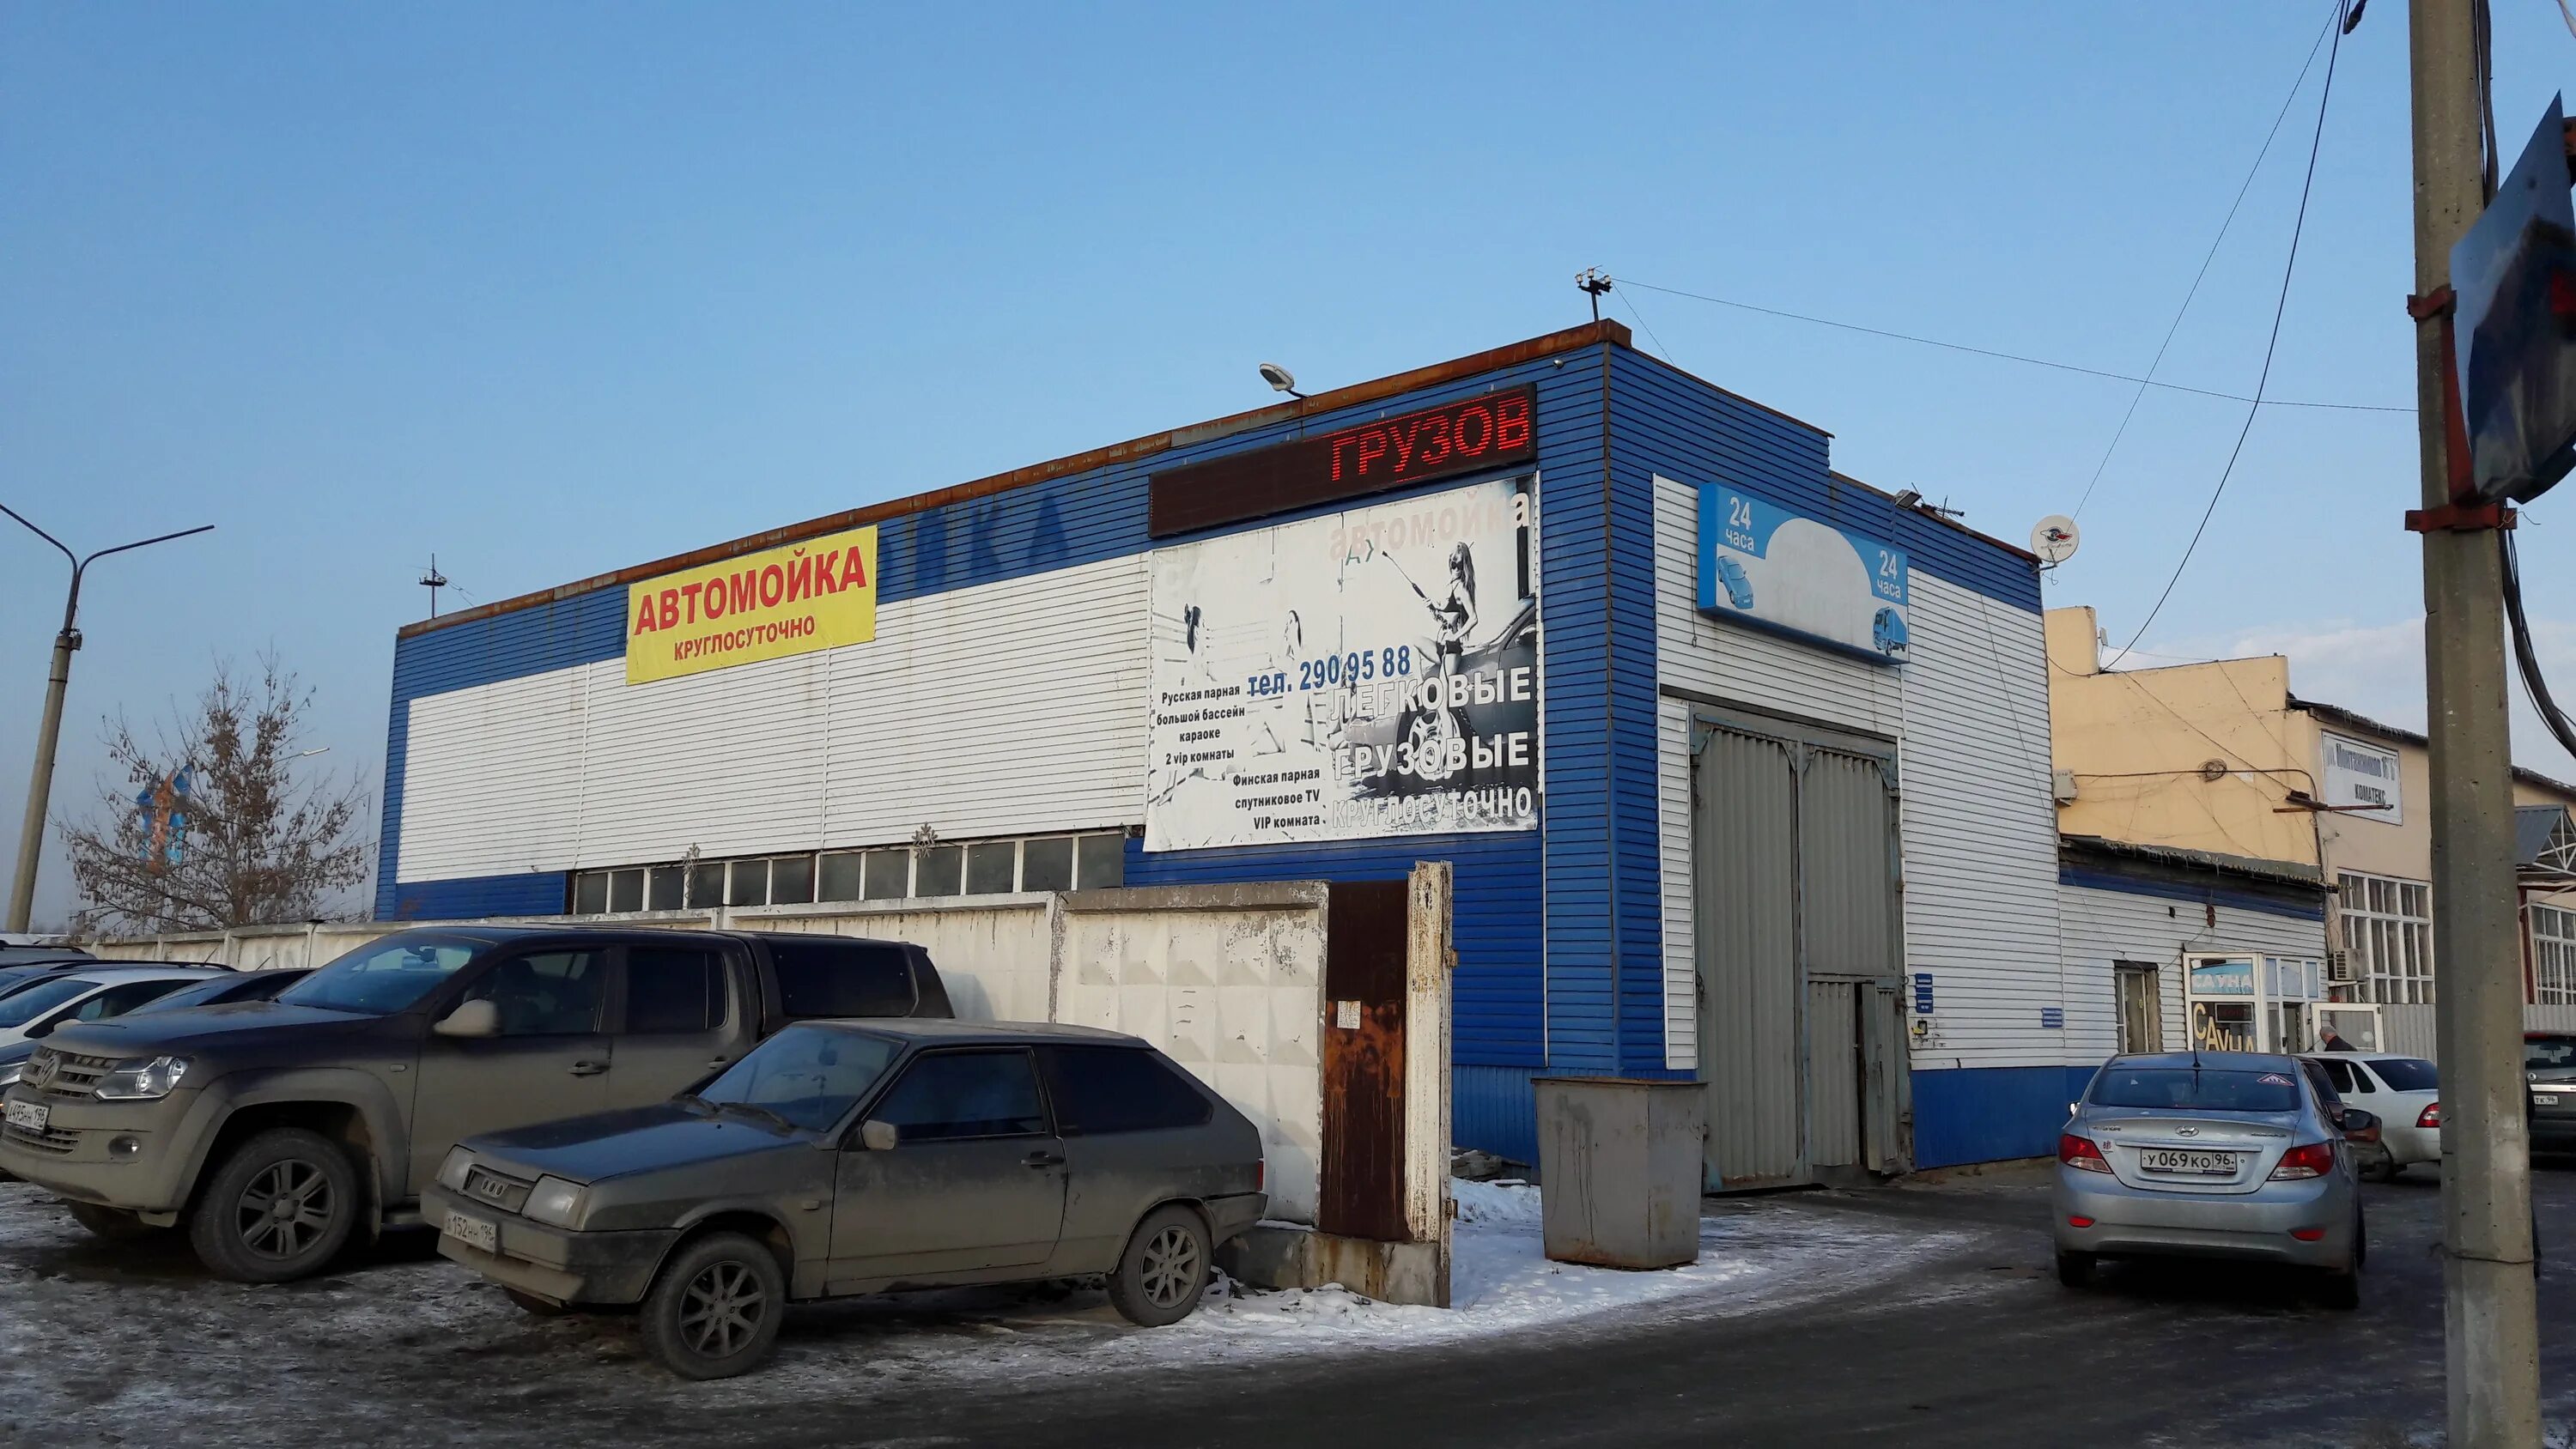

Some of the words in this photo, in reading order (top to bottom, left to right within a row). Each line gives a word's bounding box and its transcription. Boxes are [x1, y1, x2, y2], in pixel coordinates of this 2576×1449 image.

[1331, 395, 1530, 482] ГРУЗОВ
[1729, 496, 1752, 530] 24
[1726, 528, 1754, 552] часа
[1880, 549, 1898, 579] 24
[634, 546, 867, 635] АВТОМОЙКА
[1876, 580, 1901, 599] часа
[674, 615, 815, 661] КРУГЛОСУТОЧНО
[1248, 672, 1292, 697] тел.
[1299, 655, 1340, 691] 290
[1347, 650, 1374, 682] 95
[1382, 646, 1410, 677] 88
[1162, 689, 1202, 704] Русская
[1204, 686, 1240, 702] парная
[1331, 666, 1531, 721] ЛЕГКОВЫЕ
[1157, 709, 1200, 725] большой
[1202, 705, 1245, 721] бассейн
[1180, 728, 1220, 743] караоке
[1165, 754, 1172, 765] 2
[1174, 752, 1188, 766] vip
[1190, 749, 1234, 764] комнаты
[1334, 731, 1529, 780] ГРУЗОВЫЕ
[1233, 772, 1279, 788] Финская
[1281, 769, 1320, 785] парная
[1235, 792, 1303, 810] спутниковое
[1306, 789, 1321, 803] TV
[2354, 783, 2386, 804] КОМАТЕКС
[1332, 786, 1532, 828] КРУГЛОСУТОЧНО
[1254, 815, 1271, 830] VIP
[1273, 815, 1320, 829] комната
